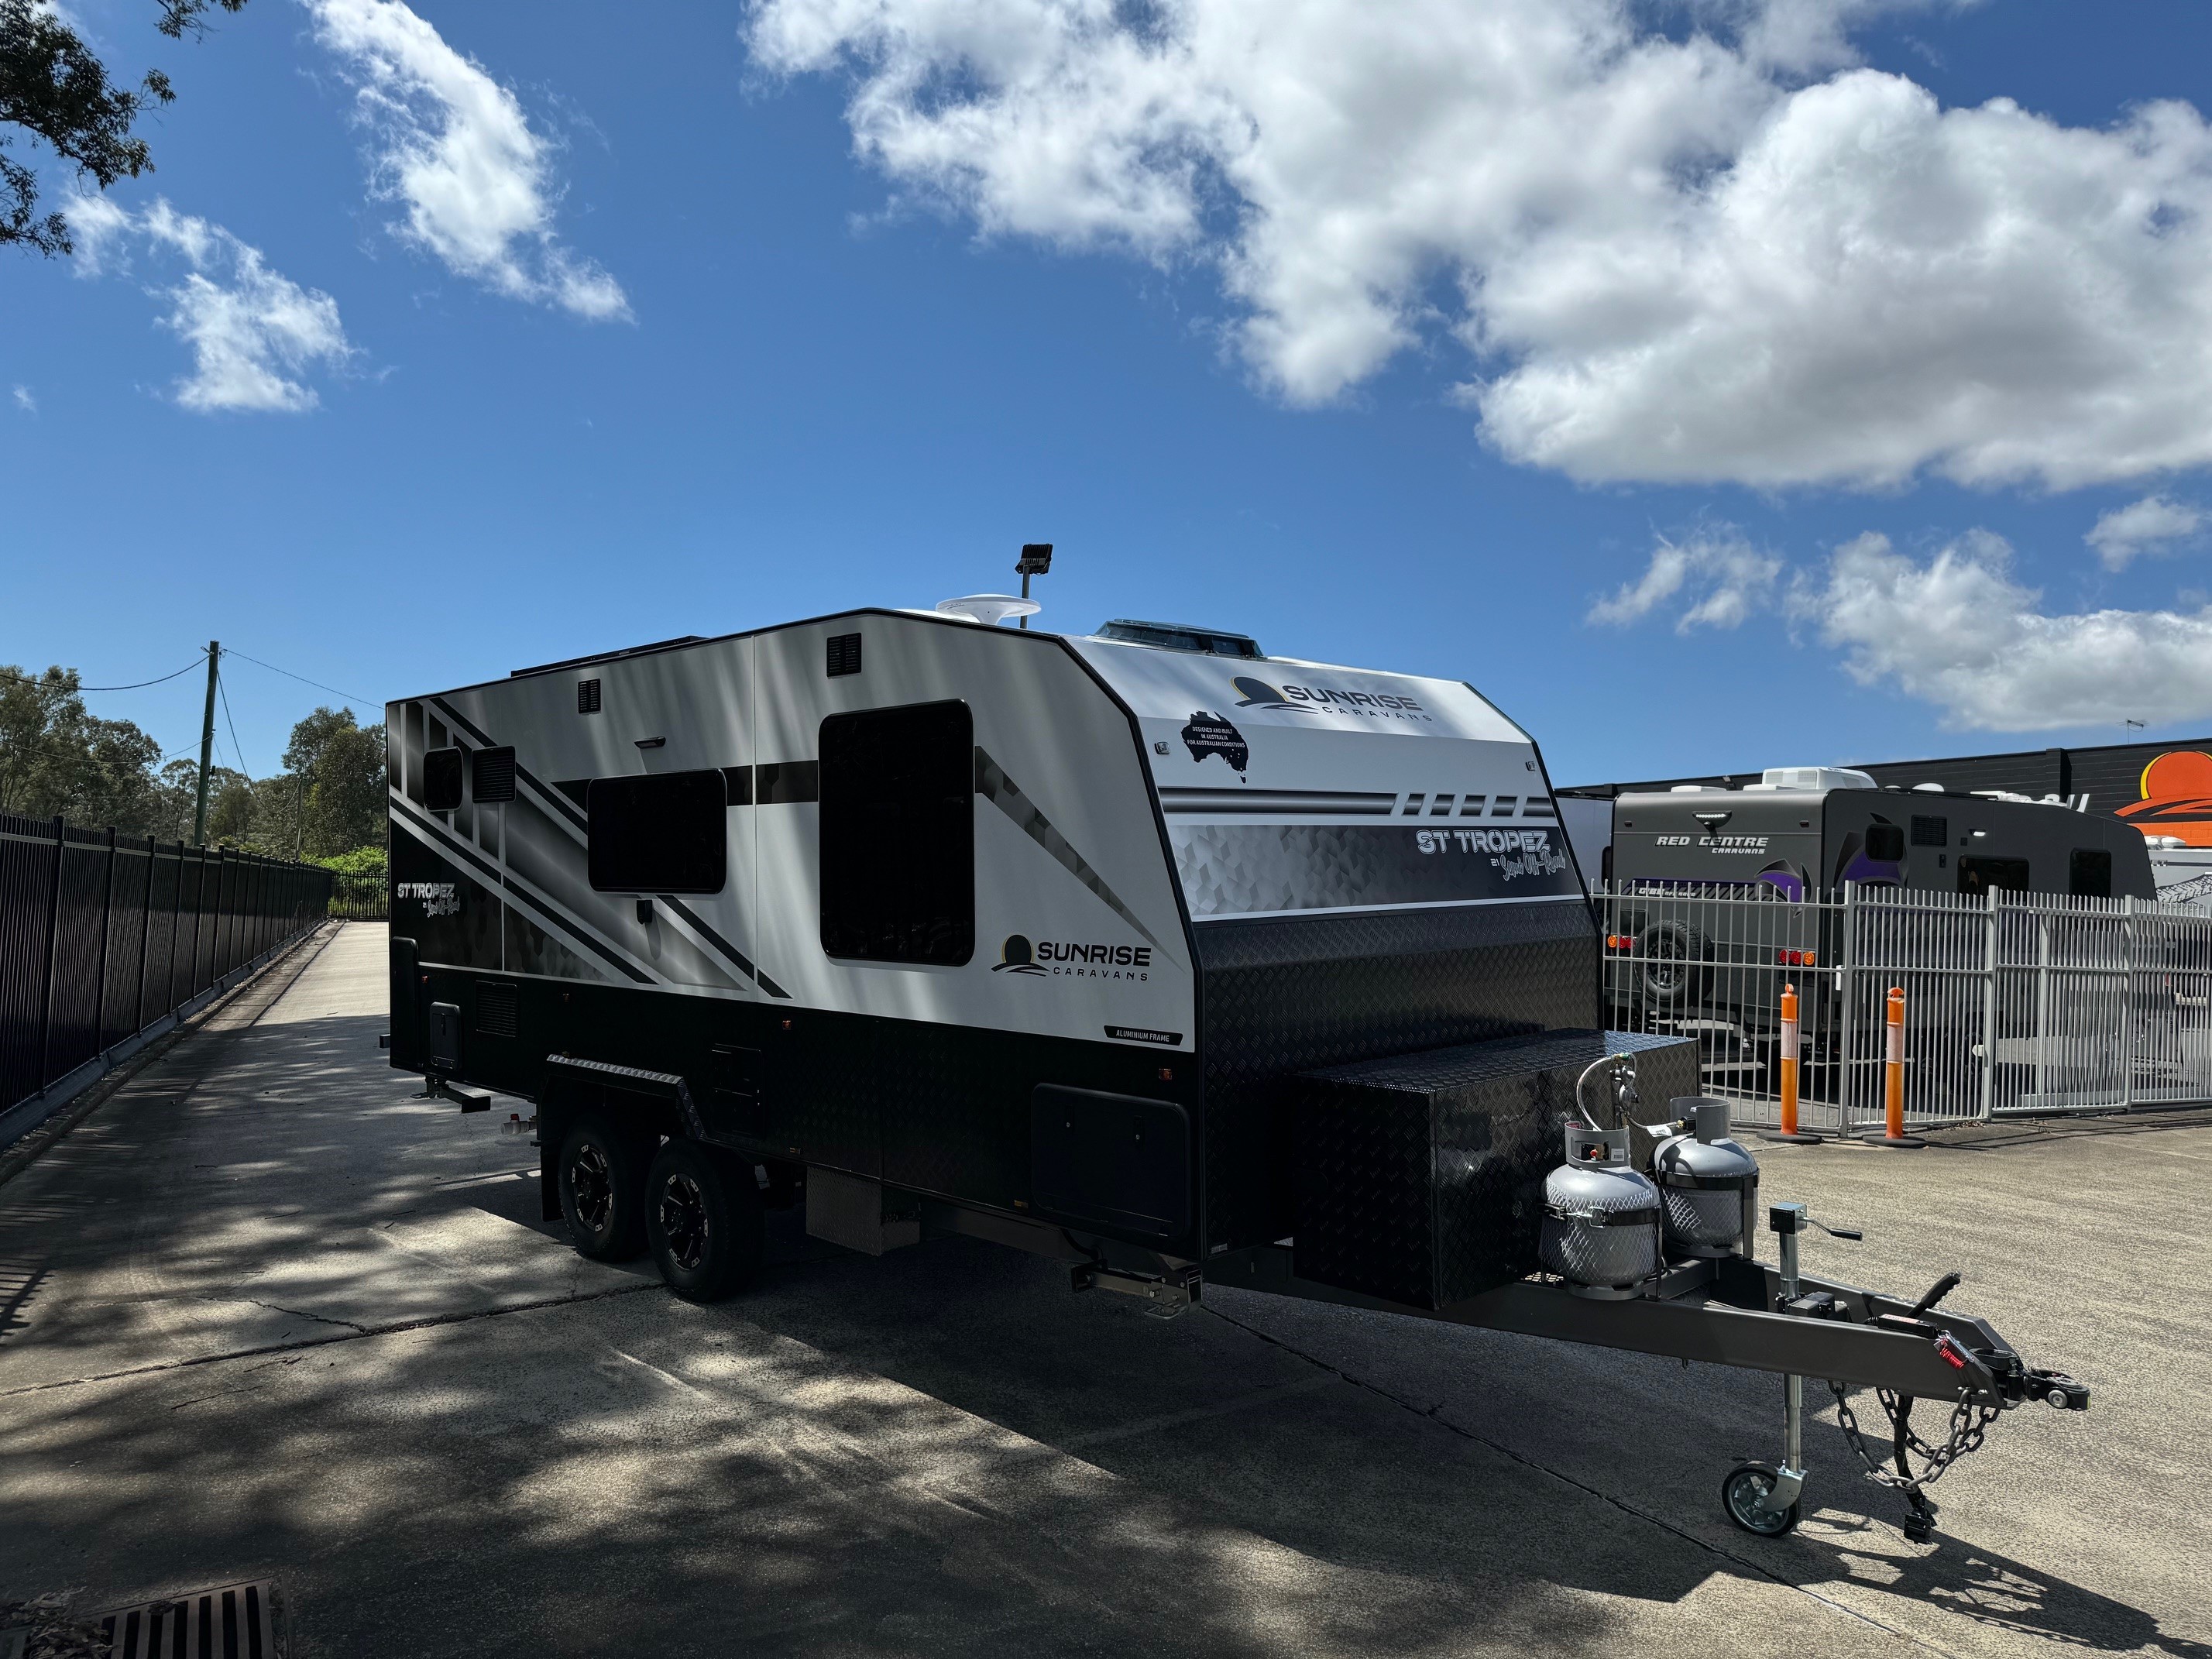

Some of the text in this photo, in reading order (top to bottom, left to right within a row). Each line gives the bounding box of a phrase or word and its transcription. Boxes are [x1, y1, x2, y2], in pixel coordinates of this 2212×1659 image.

[1282, 685, 1424, 711] SUNRISE
[1322, 706, 1432, 722] CARAVANS
[1416, 830, 1551, 854] ST TROPEZ
[1656, 836, 1769, 847] RED CENTRE
[397, 882, 455, 898] ST TROPEZ
[1037, 941, 1152, 967] SUNRISE
[1053, 967, 1148, 981] CARAVANS
[1115, 1029, 1170, 1042] ALUMINIUM FRAME
